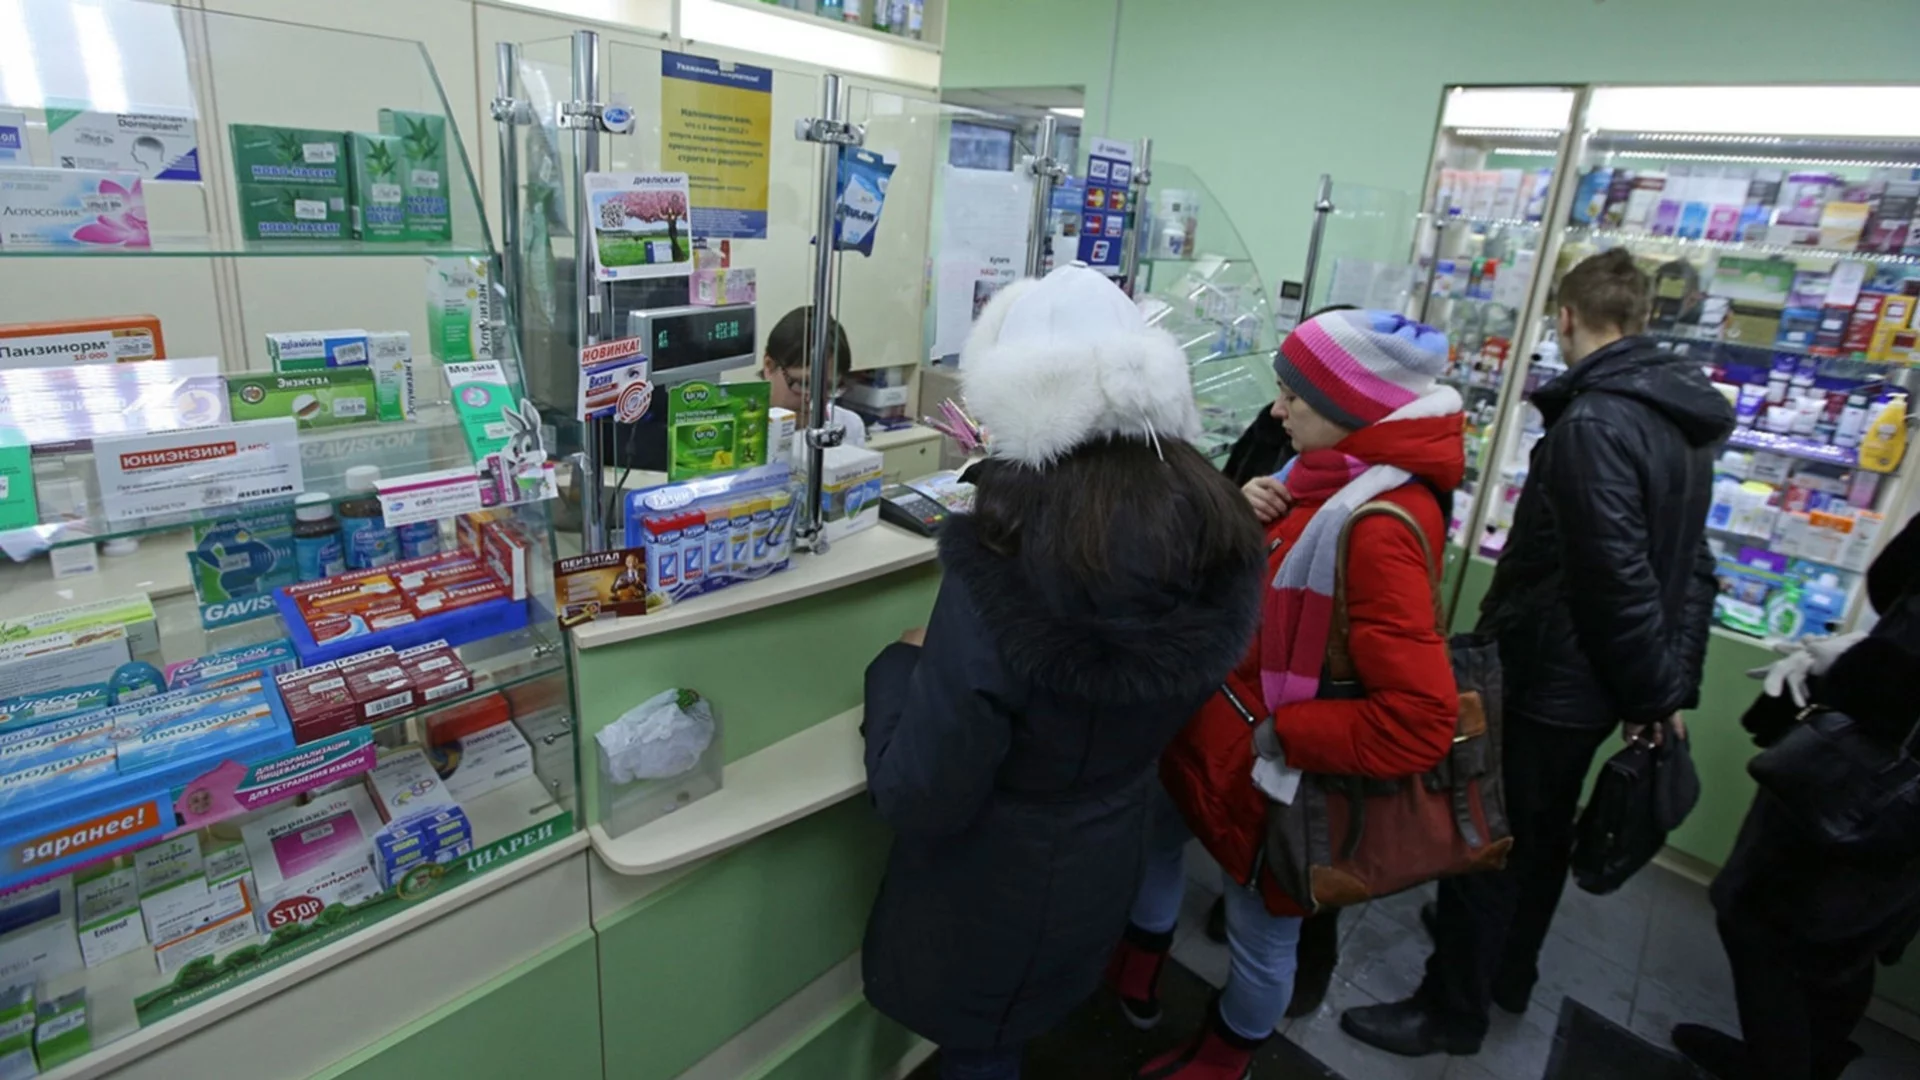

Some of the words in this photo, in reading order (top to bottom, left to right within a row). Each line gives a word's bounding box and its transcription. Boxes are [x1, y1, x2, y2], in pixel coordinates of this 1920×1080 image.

[1093, 163, 1107, 173] VISA
[1115, 167, 1129, 177] VISA
[0, 341, 108, 358] Панзинорм
[582, 340, 640, 362] НОВИНКА!
[448, 363, 497, 374] Мезим
[277, 377, 330, 389] Энзистал
[561, 552, 620, 569] ПЕНЗИТАЛ
[308, 584, 358, 601] Ренни
[449, 582, 496, 599] Ренни
[204, 594, 275, 622] GAVIS
[402, 640, 447, 656] АСТАЛ
[178, 646, 269, 674] GAVISCON
[255, 765, 275, 777] ДЛЯ
[276, 740, 351, 770] НОРМАЛИЗАЦИИ
[256, 755, 325, 782] ПИЩЕВАРЕНИЯ
[248, 789, 269, 802] ДЛЯ
[270, 769, 328, 794] УСТРАНЕНИЯ
[329, 757, 365, 774] ИЗЖОГИ
[22, 808, 146, 864] заранее!
[273, 900, 321, 925] STOP
[94, 918, 129, 938] Enterol
